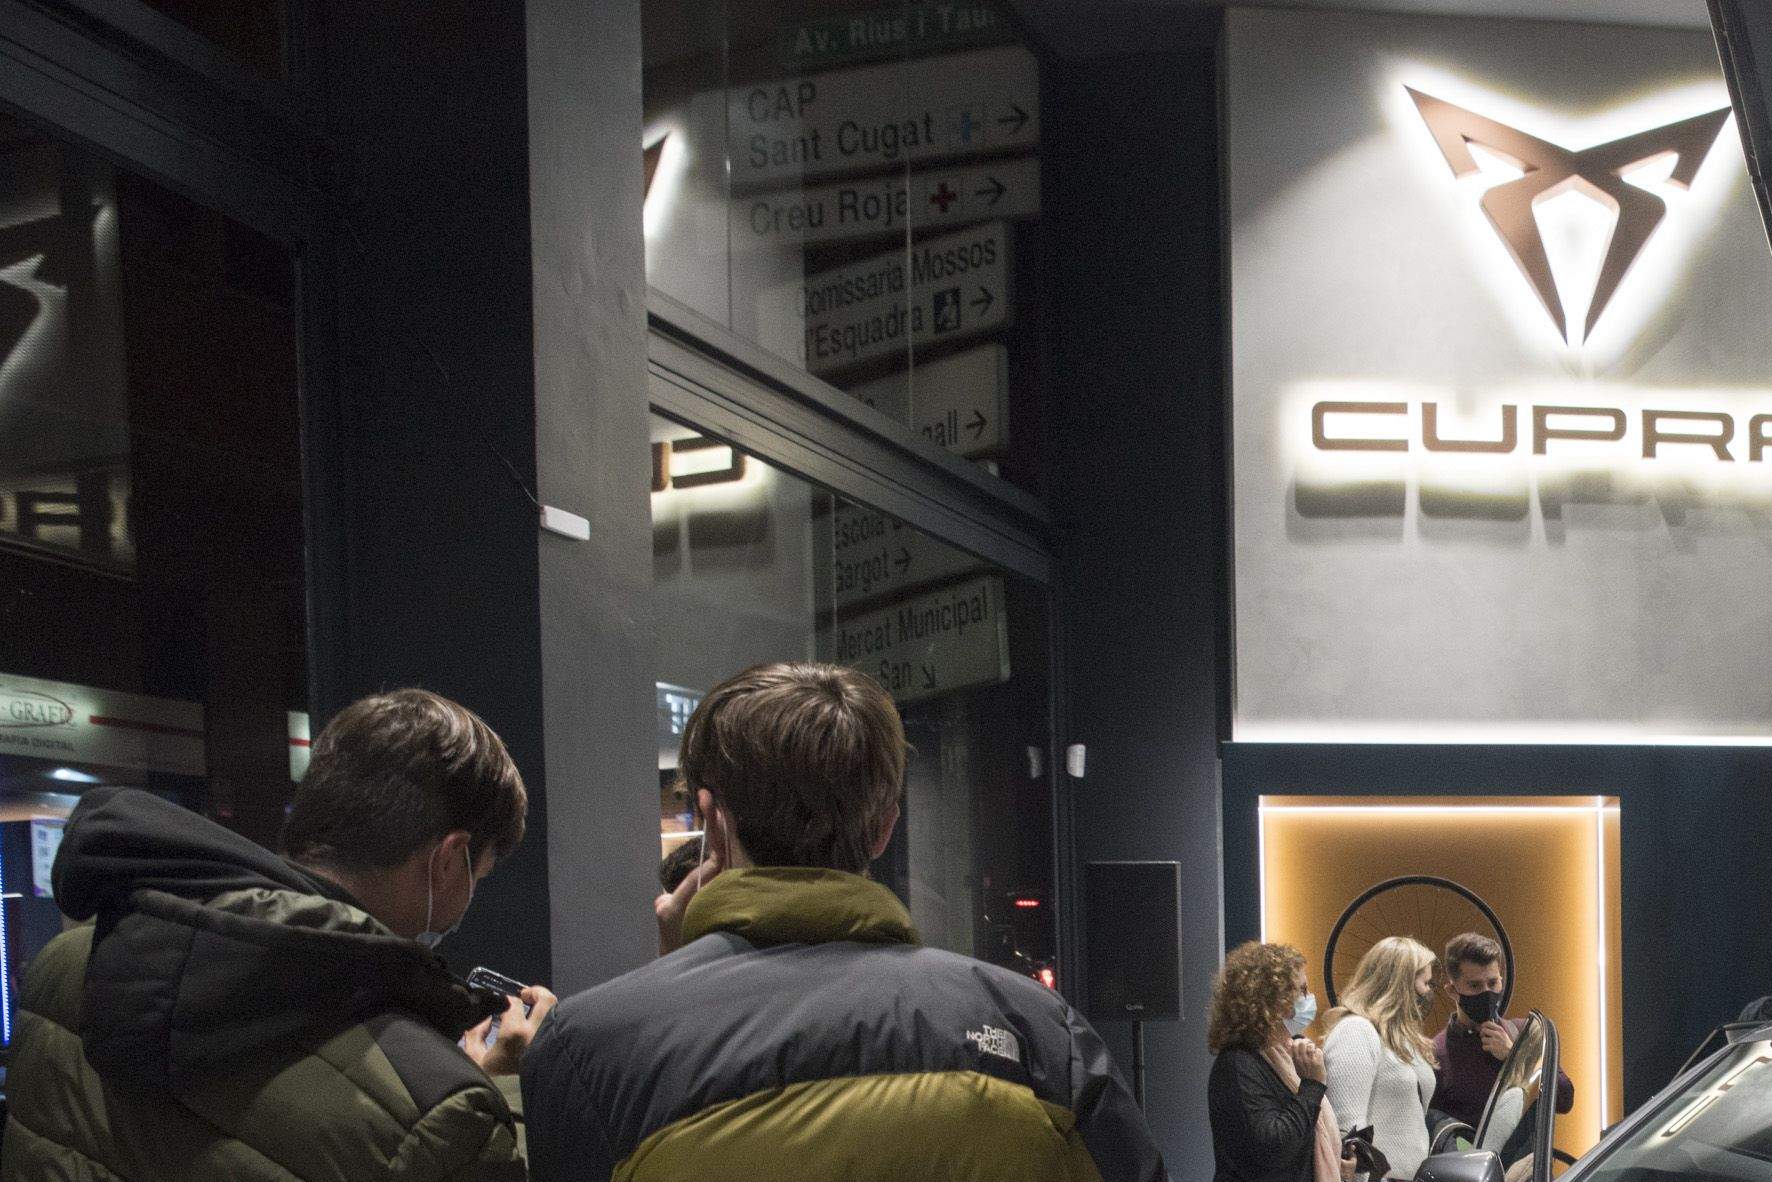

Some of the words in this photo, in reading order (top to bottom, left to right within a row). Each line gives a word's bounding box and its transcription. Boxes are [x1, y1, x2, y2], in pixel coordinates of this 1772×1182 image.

[748, 82, 816, 121] CAP
[749, 129, 823, 169] Sant
[837, 112, 935, 159] Cugat
[750, 201, 824, 236] Creu
[839, 183, 908, 228] Roja
[911, 239, 997, 287] Mossos
[897, 585, 988, 642] Municipal
[965, 1029, 1006, 1049] NORTH
[977, 1040, 1006, 1057] FACE
[982, 1024, 1005, 1039] THE
